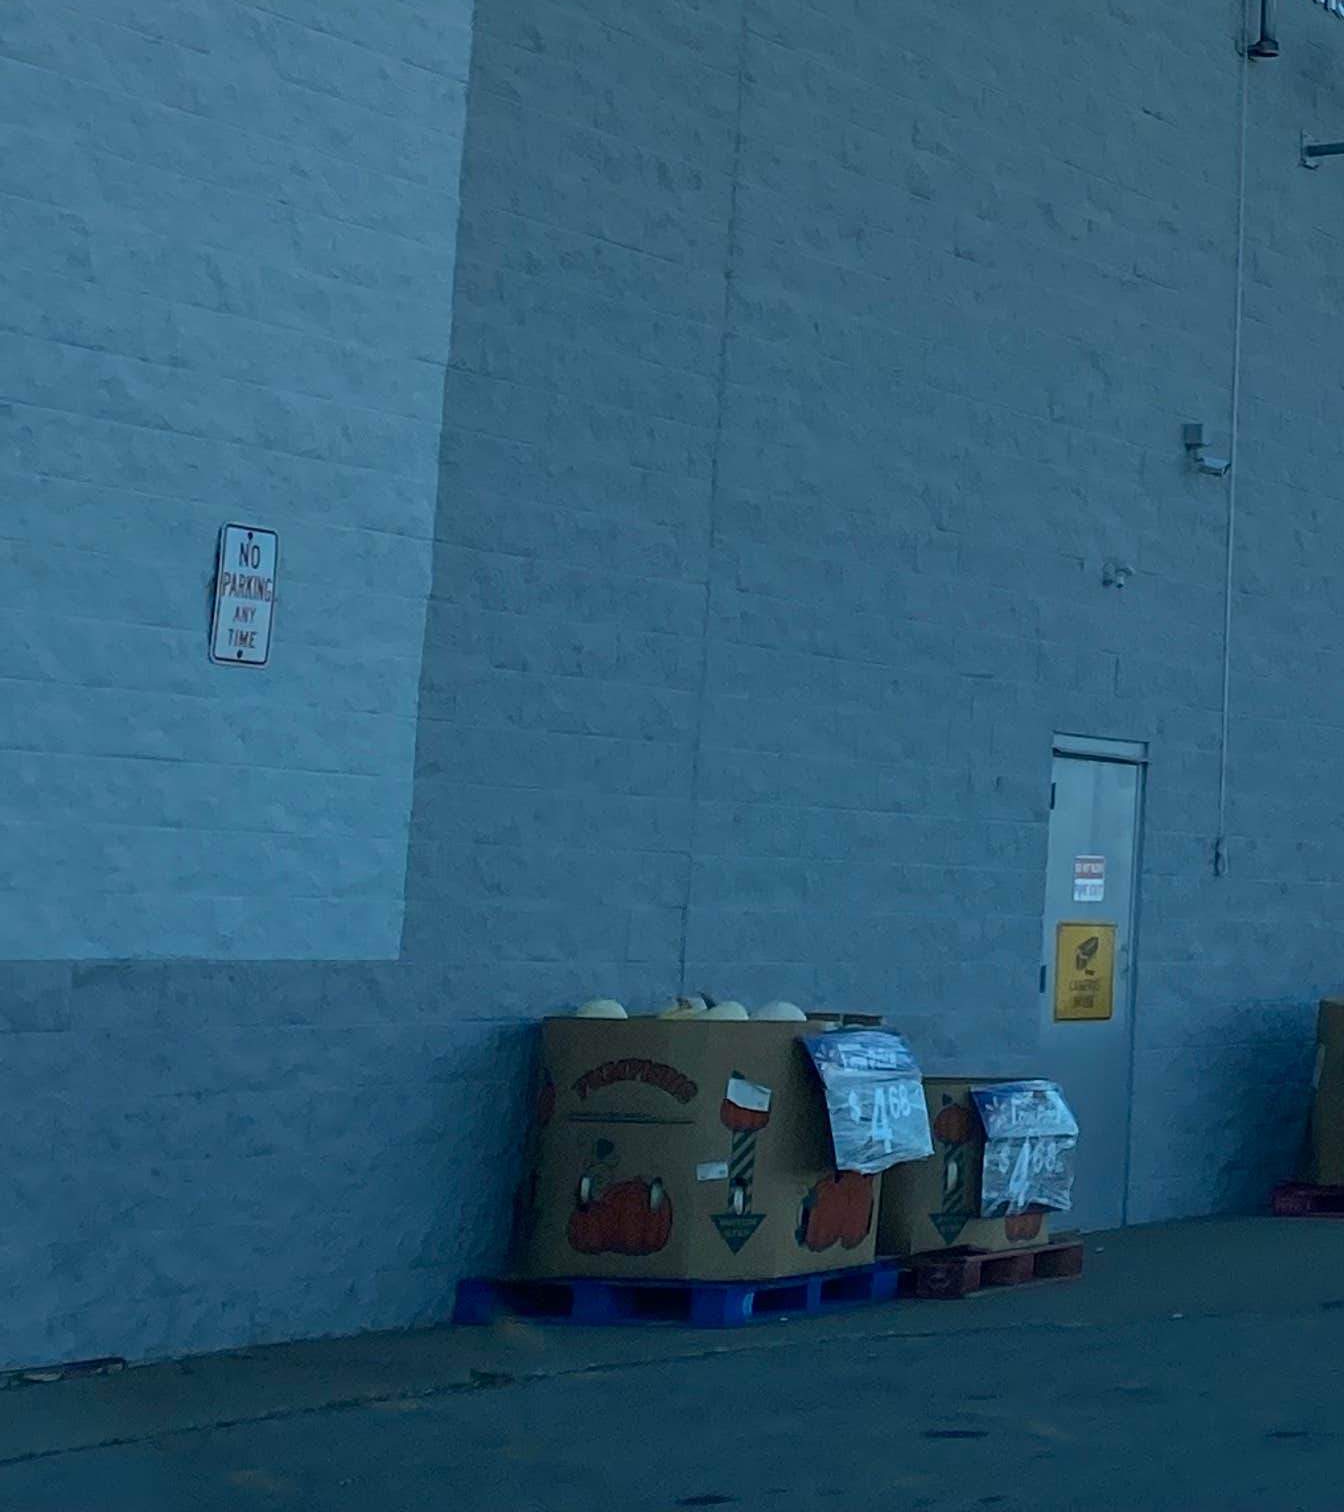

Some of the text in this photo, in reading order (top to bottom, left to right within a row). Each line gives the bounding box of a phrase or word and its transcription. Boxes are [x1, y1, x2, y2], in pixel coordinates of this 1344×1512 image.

[239, 543, 260, 569] NO
[222, 572, 273, 602] PARKING
[232, 606, 256, 623] ANY
[228, 629, 257, 649] TIME
